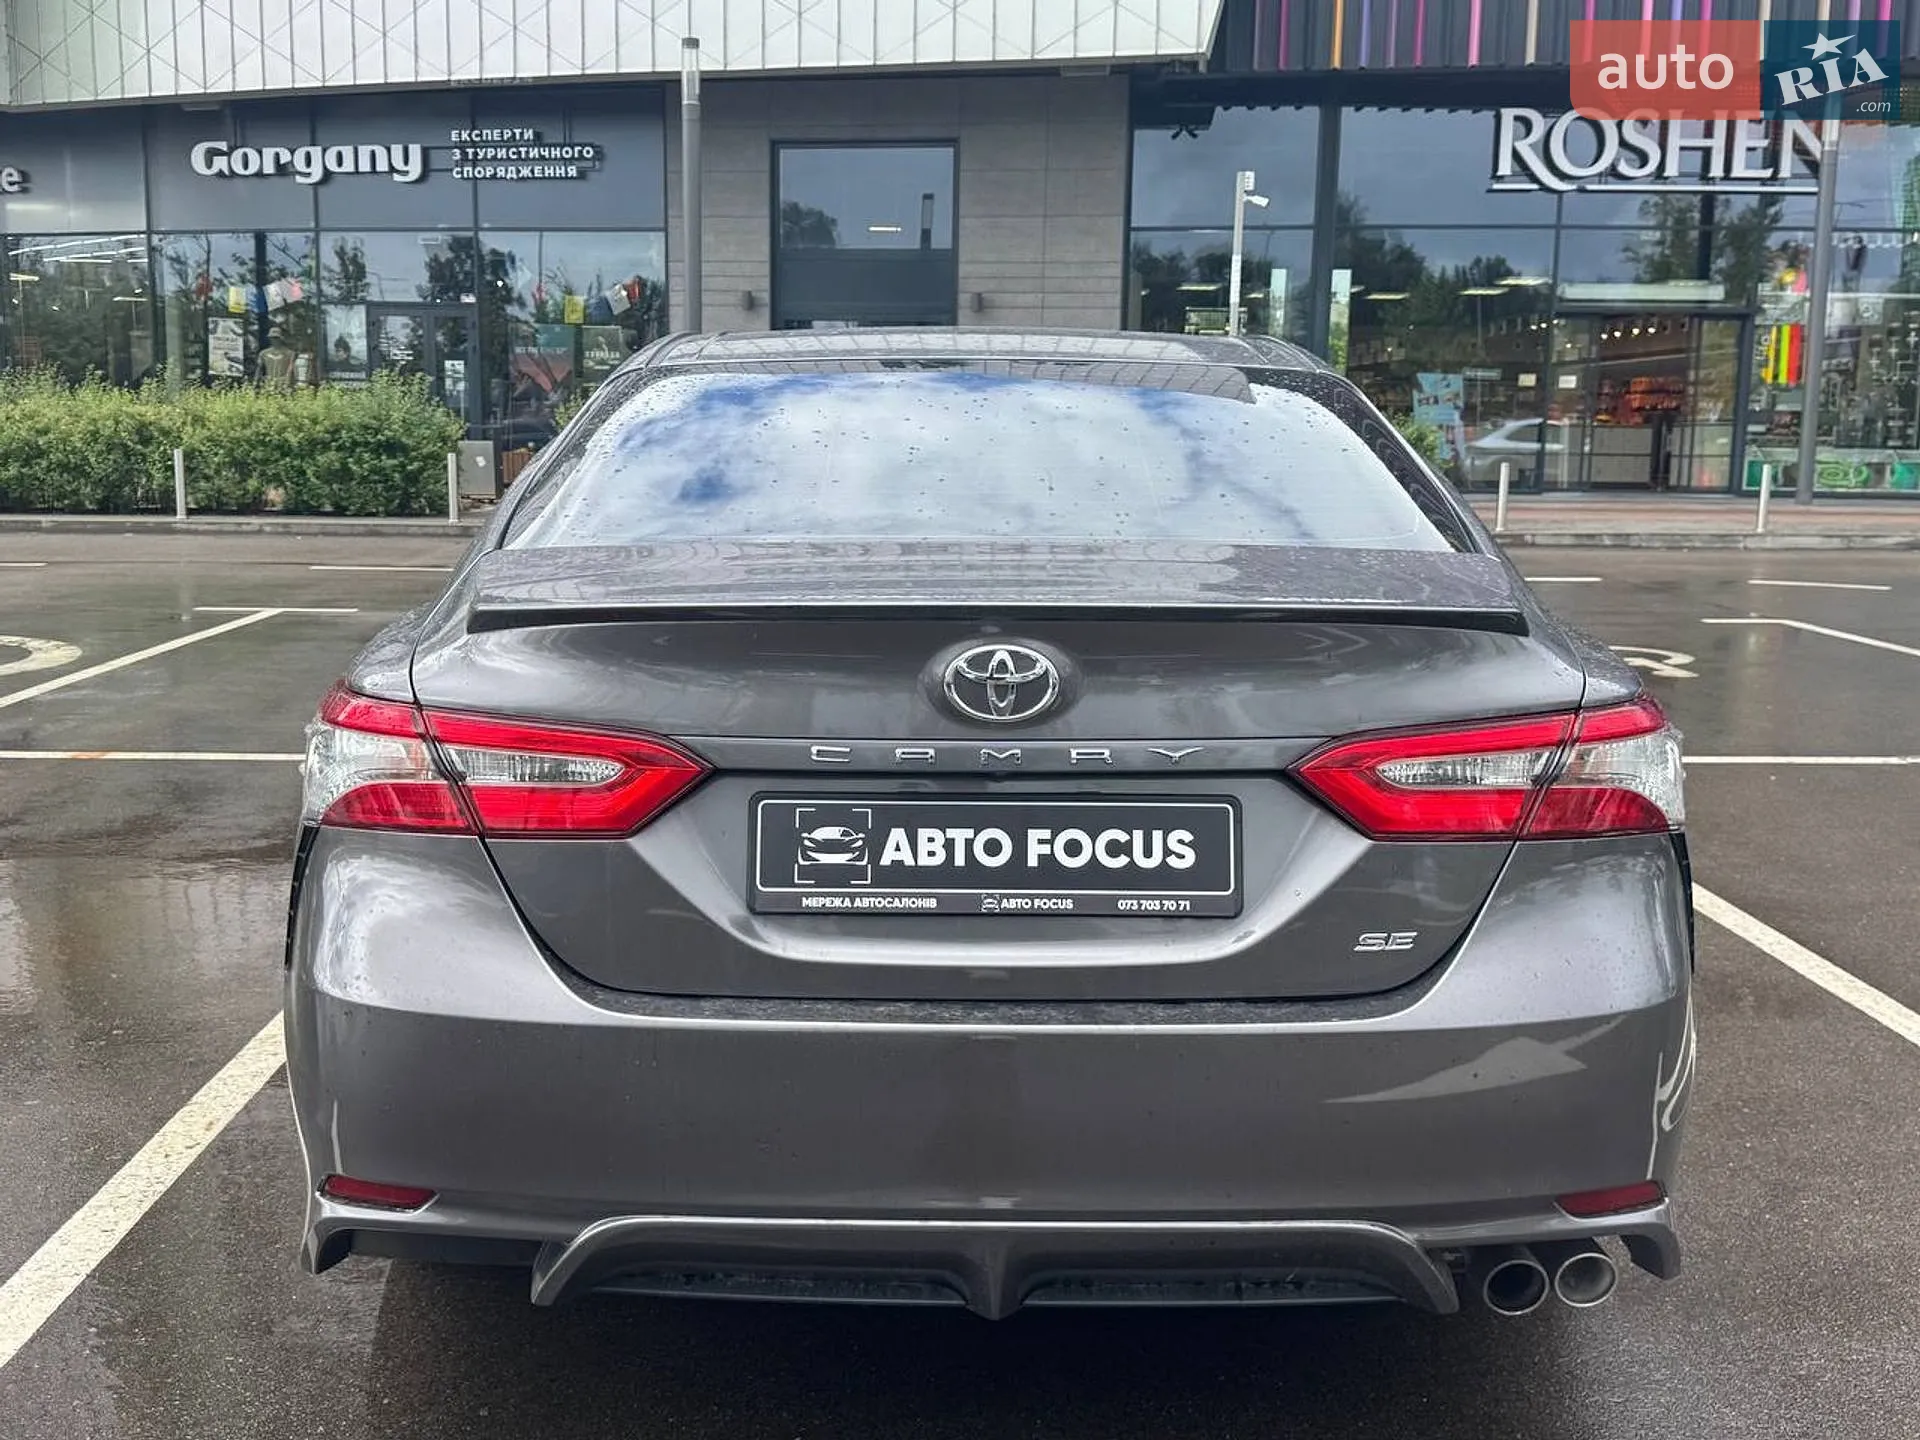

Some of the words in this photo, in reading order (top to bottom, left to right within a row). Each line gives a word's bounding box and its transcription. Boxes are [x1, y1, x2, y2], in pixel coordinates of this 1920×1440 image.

[451, 128, 534, 141] ЕКСПЕРТИ
[451, 149, 461, 160] З
[466, 146, 594, 159] ТУРИСТИЧНОГО
[1496, 107, 1824, 192] ROSHEN
[190, 140, 423, 185] Gorgany
[452, 166, 577, 179] СПОРЯДЖЕННЯ
[810, 745, 1205, 765] CAMRY
[880, 827, 1013, 869] АВТО
[1026, 827, 1197, 870] FOCUS
[802, 896, 852, 908] МЕРЕЖА
[853, 896, 938, 909] АВТОСАЛОНІВ
[1000, 898, 1032, 909] АВТО
[1033, 898, 1074, 909] FOCUS
[1117, 900, 1139, 911] 073
[1140, 900, 1160, 911] 703
[1162, 900, 1177, 911] 70
[1178, 900, 1191, 911] 71
[1353, 931, 1418, 952] SE
